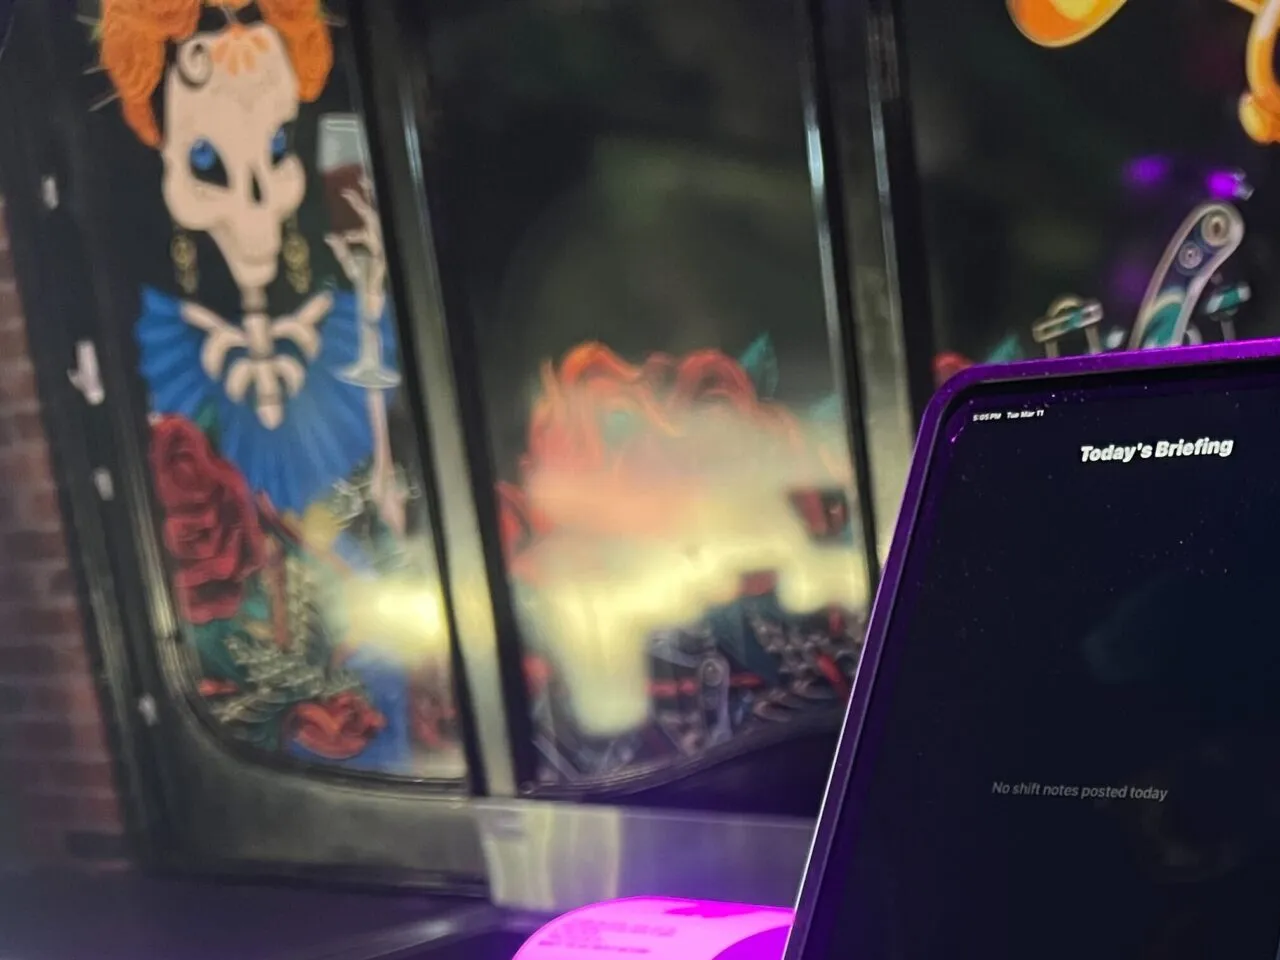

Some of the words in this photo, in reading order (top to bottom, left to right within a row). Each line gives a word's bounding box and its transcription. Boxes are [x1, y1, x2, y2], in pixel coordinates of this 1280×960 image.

[1007, 411, 1020, 419] Tue
[1021, 410, 1035, 418] Mar
[1080, 442, 1153, 463] Today's
[1154, 437, 1234, 458] Briefing
[991, 781, 1011, 795] No
[1012, 782, 1041, 796] shift
[1042, 784, 1079, 797] notes
[1080, 785, 1129, 799] posted
[1129, 786, 1168, 802] today
